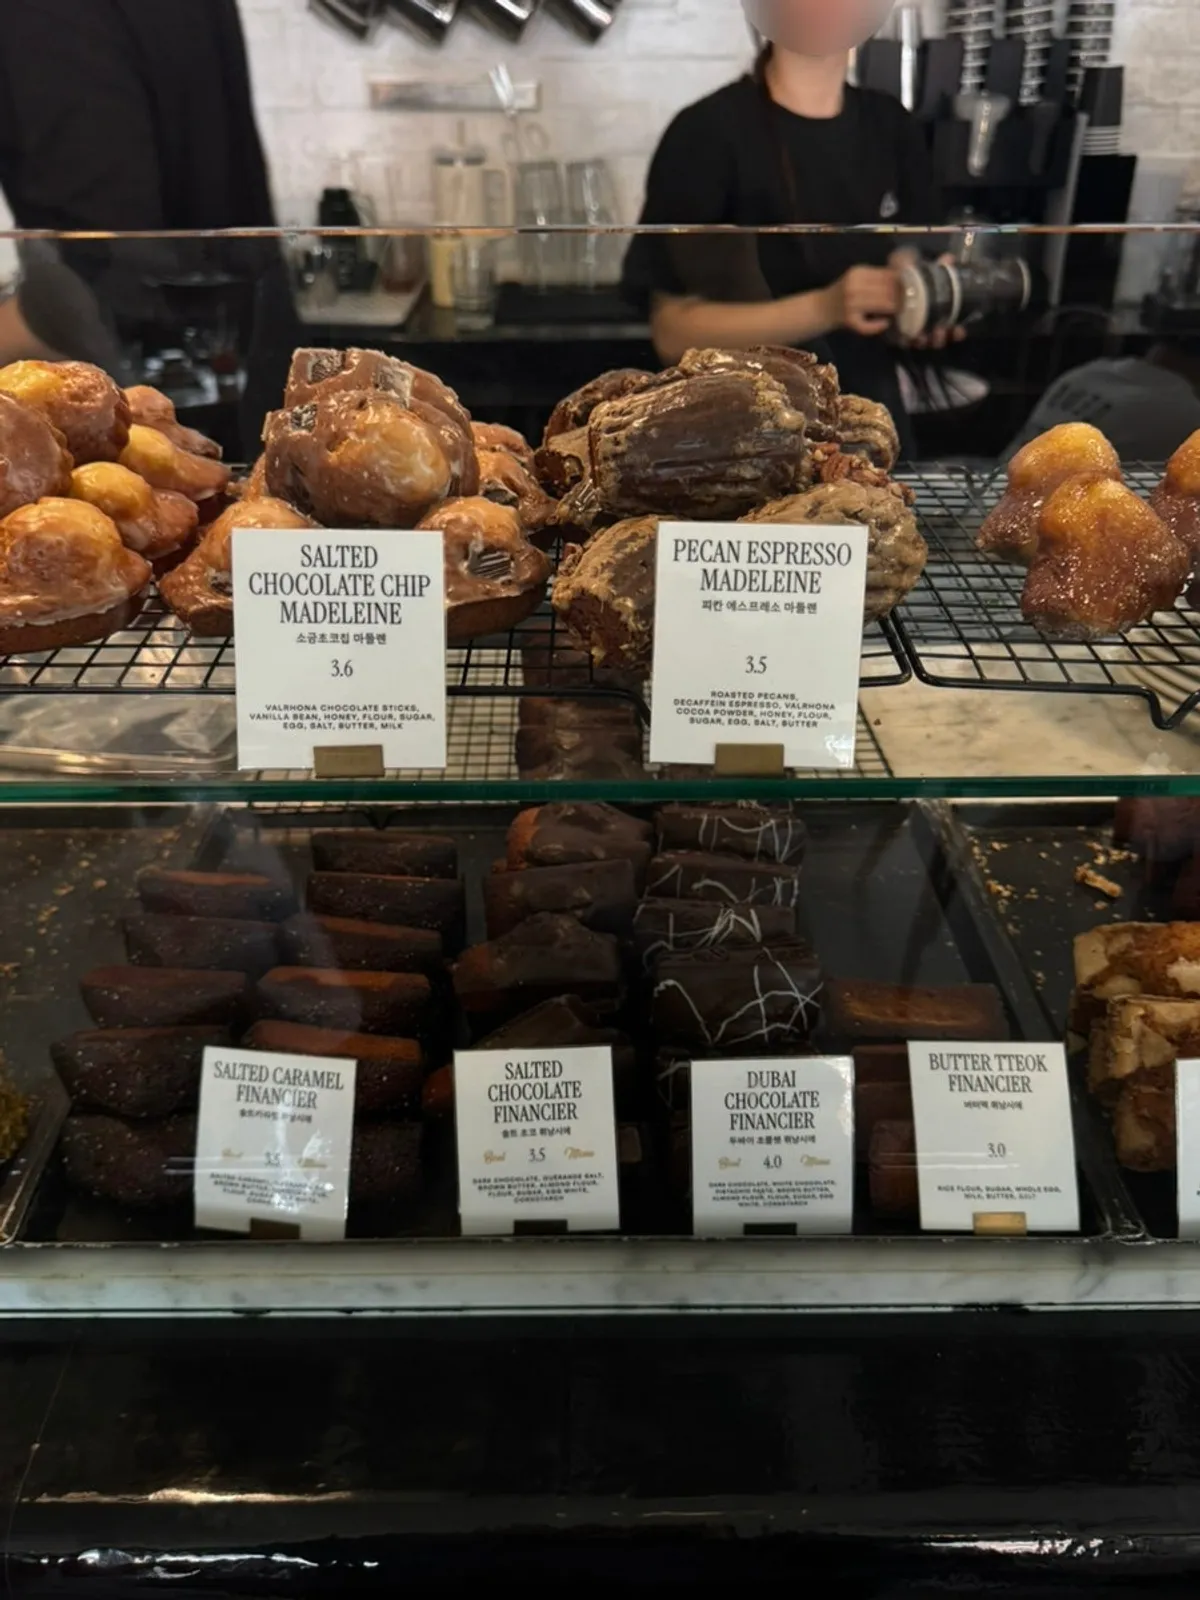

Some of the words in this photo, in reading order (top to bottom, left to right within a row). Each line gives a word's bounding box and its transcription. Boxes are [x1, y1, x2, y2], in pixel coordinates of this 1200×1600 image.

[301, 544, 378, 568] SALTED
[673, 539, 741, 563] PECAN
[746, 541, 852, 566] ESPRESSO
[249, 573, 375, 596] CHOCOLATE
[380, 575, 431, 597] CHIP
[700, 569, 821, 594] MADELEINE
[280, 601, 402, 625] MADELEINE
[702, 600, 722, 611] 피칸
[726, 601, 781, 612] 에스프레소
[784, 602, 817, 614] 마들렌
[296, 632, 349, 644] 소금초코칩
[354, 633, 386, 645] 마들렌
[331, 659, 353, 677] 3.6
[745, 656, 767, 674] 3.5
[673, 698, 725, 706] DECAFFEIN
[729, 700, 782, 709] ESPRESSO,
[785, 702, 835, 710] VALRHONA
[711, 691, 755, 699] ROASTED
[758, 692, 798, 701] PECANS,
[689, 717, 724, 726] SUGAR,
[728, 718, 750, 726] EGG,
[754, 719, 778, 727] SALT,
[782, 720, 817, 728] BUTTER
[714, 709, 756, 717] POWDER,
[760, 710, 794, 719] HONEY,
[797, 712, 832, 720] FLOUR,
[283, 722, 306, 730] EGG,
[505, 1060, 563, 1080] SALTED
[929, 1053, 992, 1071] BUTTER
[994, 1054, 1048, 1071] TTEOK
[214, 1061, 269, 1082] SALTED
[272, 1067, 343, 1090] CARAMEL
[748, 1071, 796, 1088] DUBAI
[949, 1075, 1033, 1093] FINANCIER
[236, 1084, 318, 1109] FINANCIER
[488, 1081, 582, 1102] CHOCOLATE
[724, 1091, 819, 1109] CHOCOLATE
[494, 1103, 578, 1123] FINANCIER
[730, 1112, 815, 1130] FINANCIER
[529, 1148, 546, 1162] 3.5
[987, 1143, 1006, 1157] 3.0
[763, 1155, 782, 1169] 4.0
